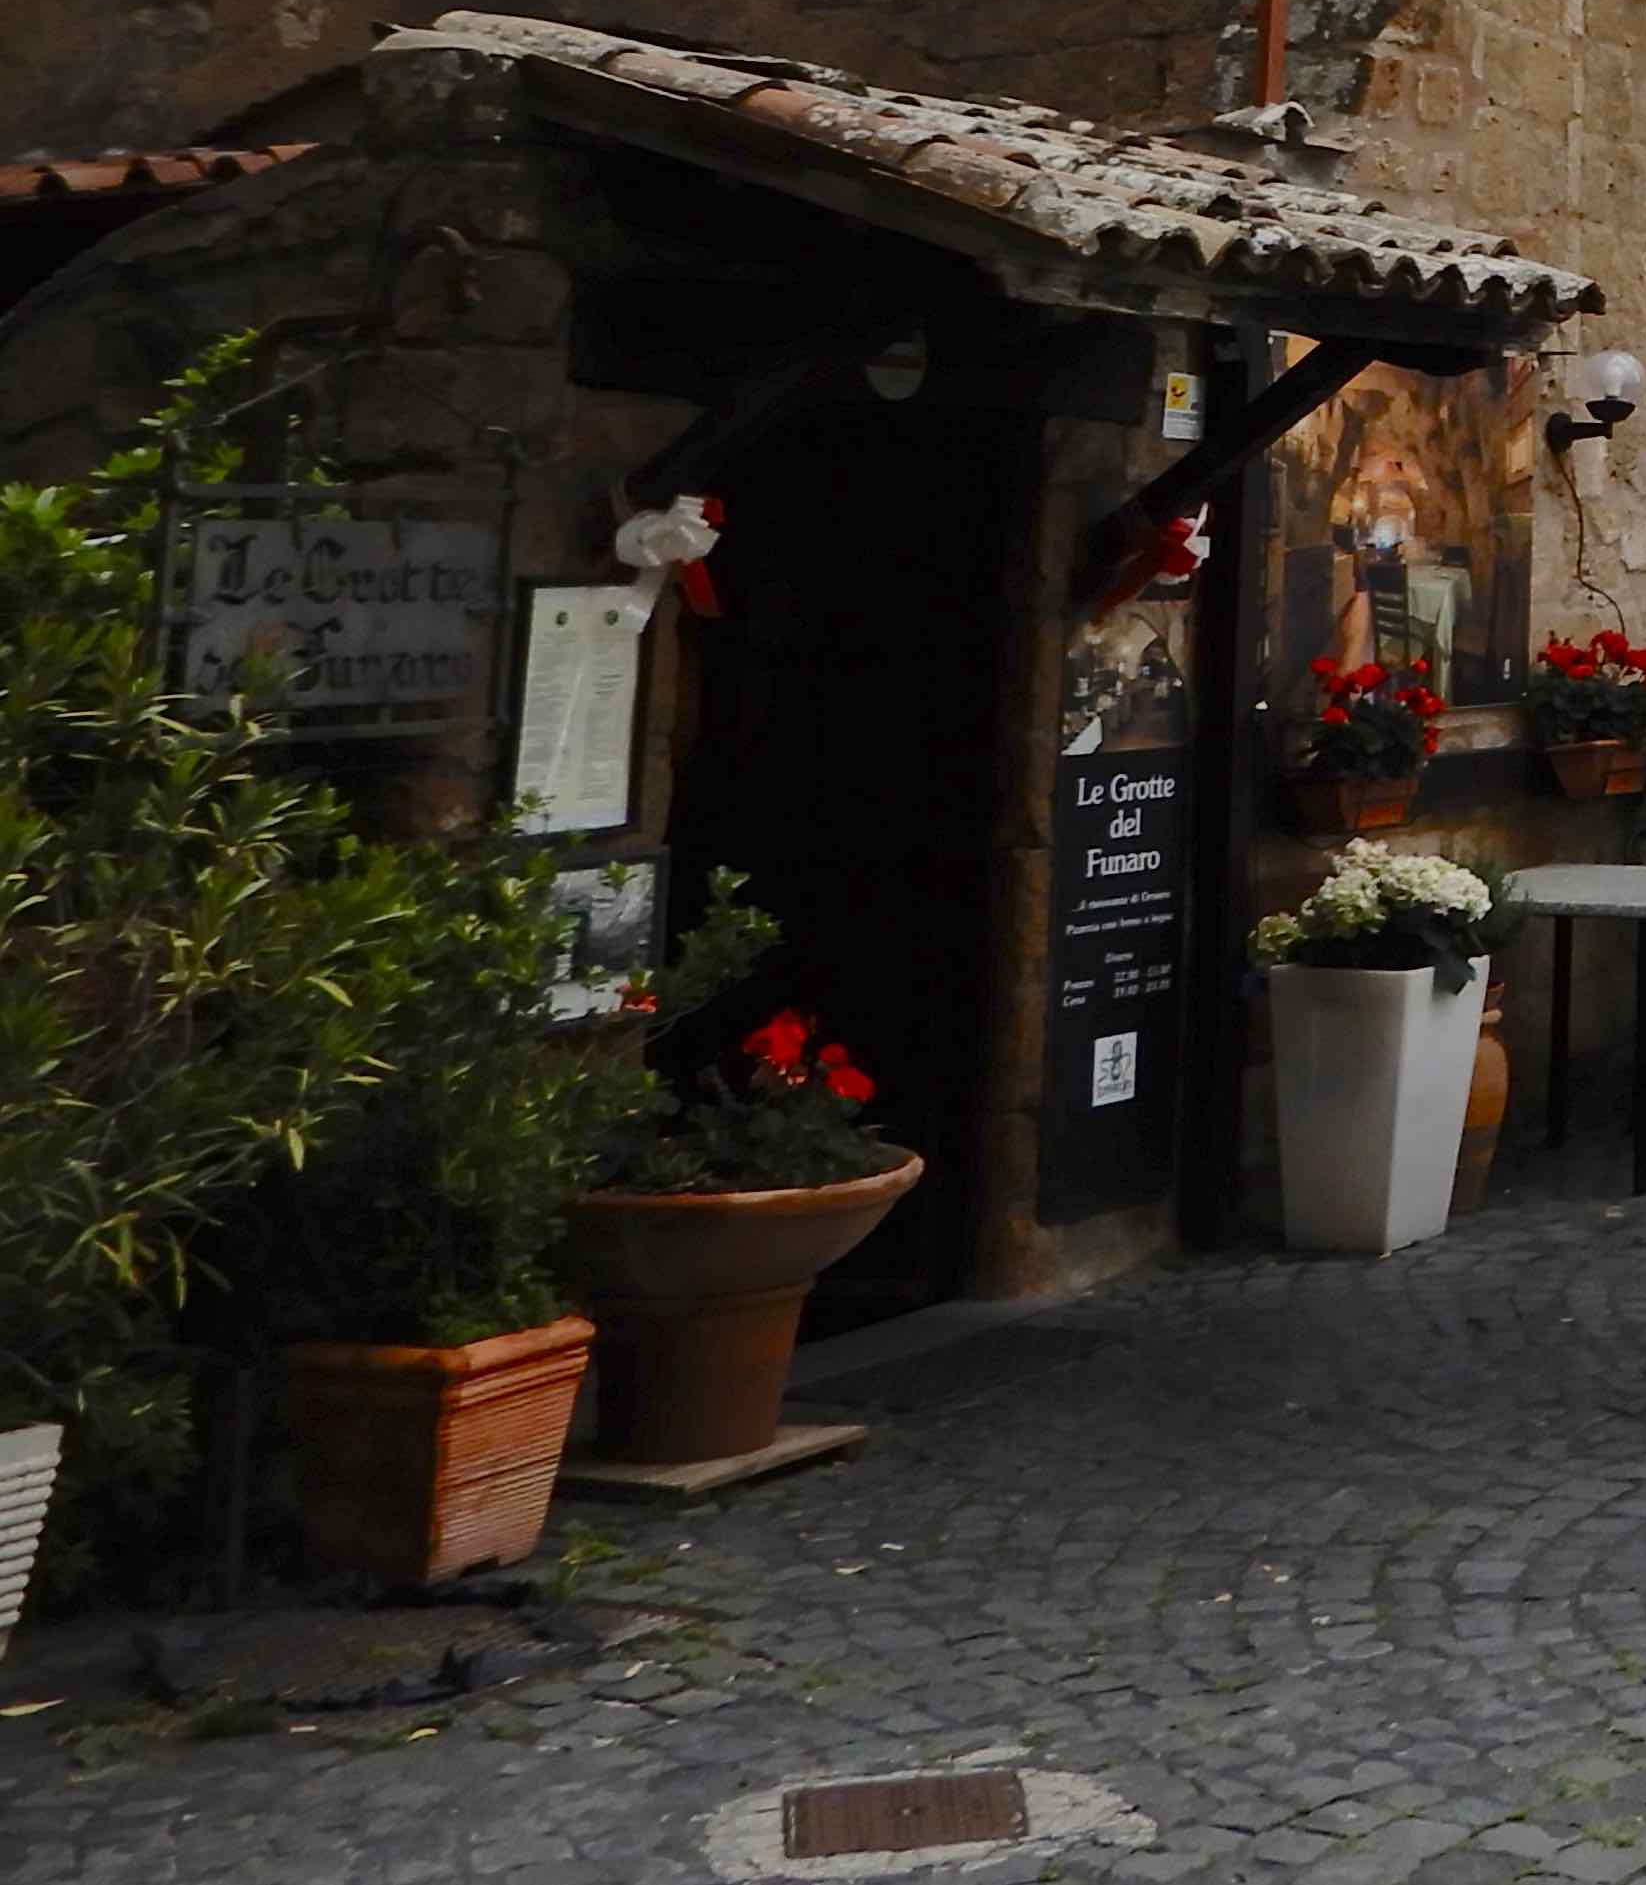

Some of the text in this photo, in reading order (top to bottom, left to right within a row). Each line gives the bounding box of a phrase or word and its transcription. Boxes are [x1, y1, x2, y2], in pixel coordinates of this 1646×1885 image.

[207, 534, 478, 605] Le Grotte
[1077, 773, 1175, 806] Le Grotte
[1110, 807, 1141, 838] del
[1086, 848, 1161, 878] Funaro
